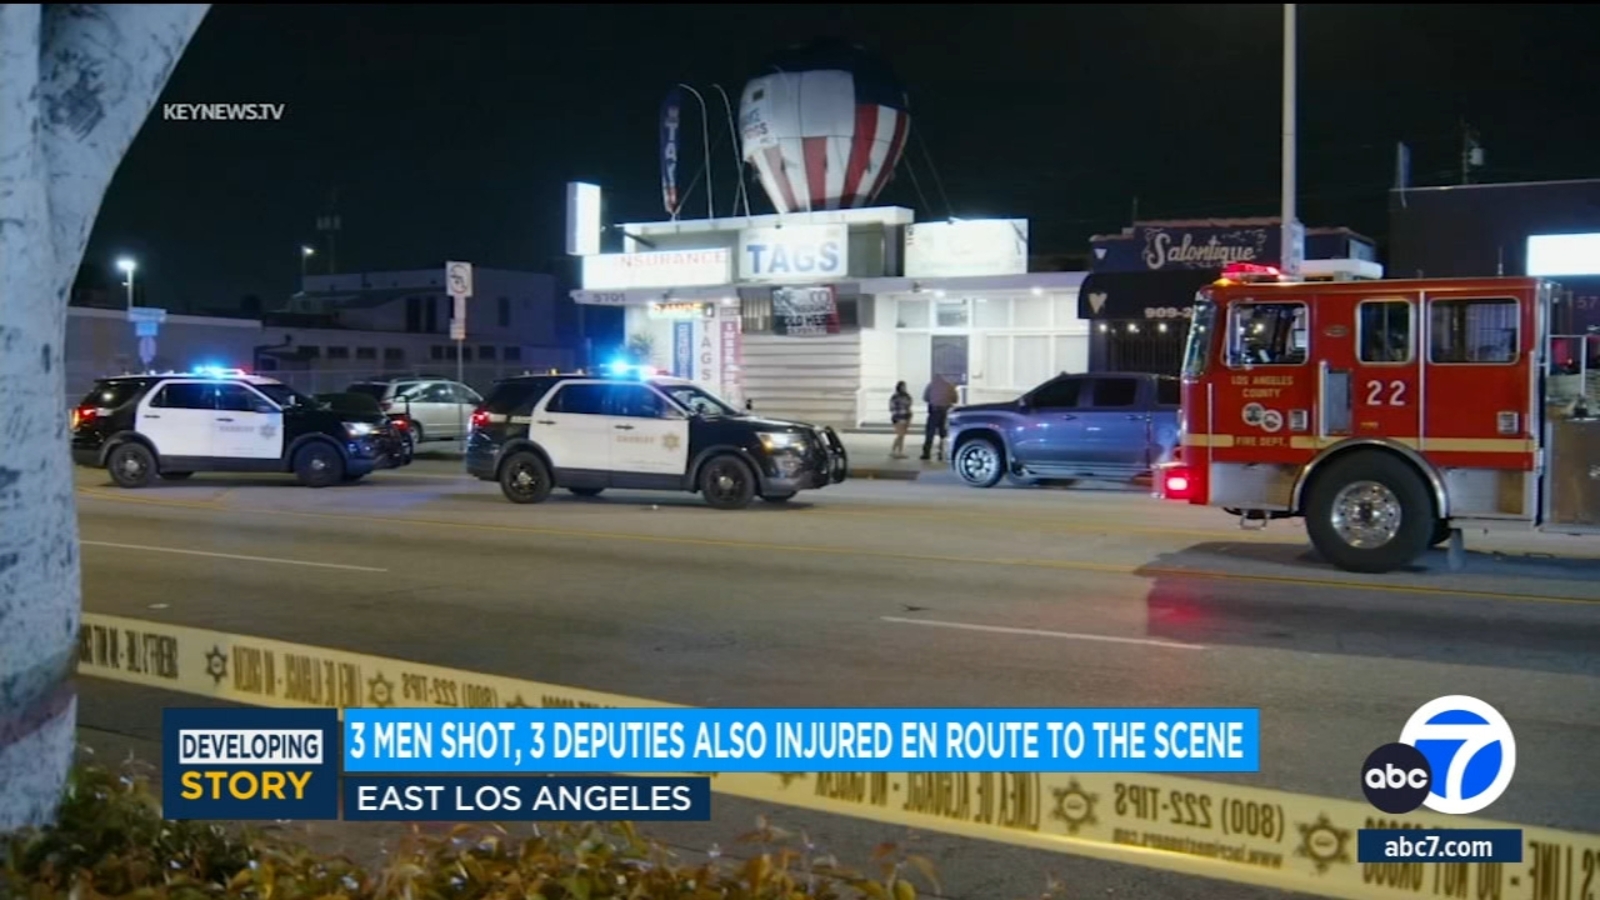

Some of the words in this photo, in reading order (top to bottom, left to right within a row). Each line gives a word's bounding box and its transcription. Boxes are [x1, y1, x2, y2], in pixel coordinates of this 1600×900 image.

[746, 241, 840, 275] TAGS
[700, 319, 712, 382] TAGS
[1230, 375, 1249, 386] LOS
[1252, 375, 1294, 386] ANGELES
[1242, 387, 1281, 398] COUNTY
[1366, 379, 1406, 406] 22
[1236, 435, 1257, 447] FIRE
